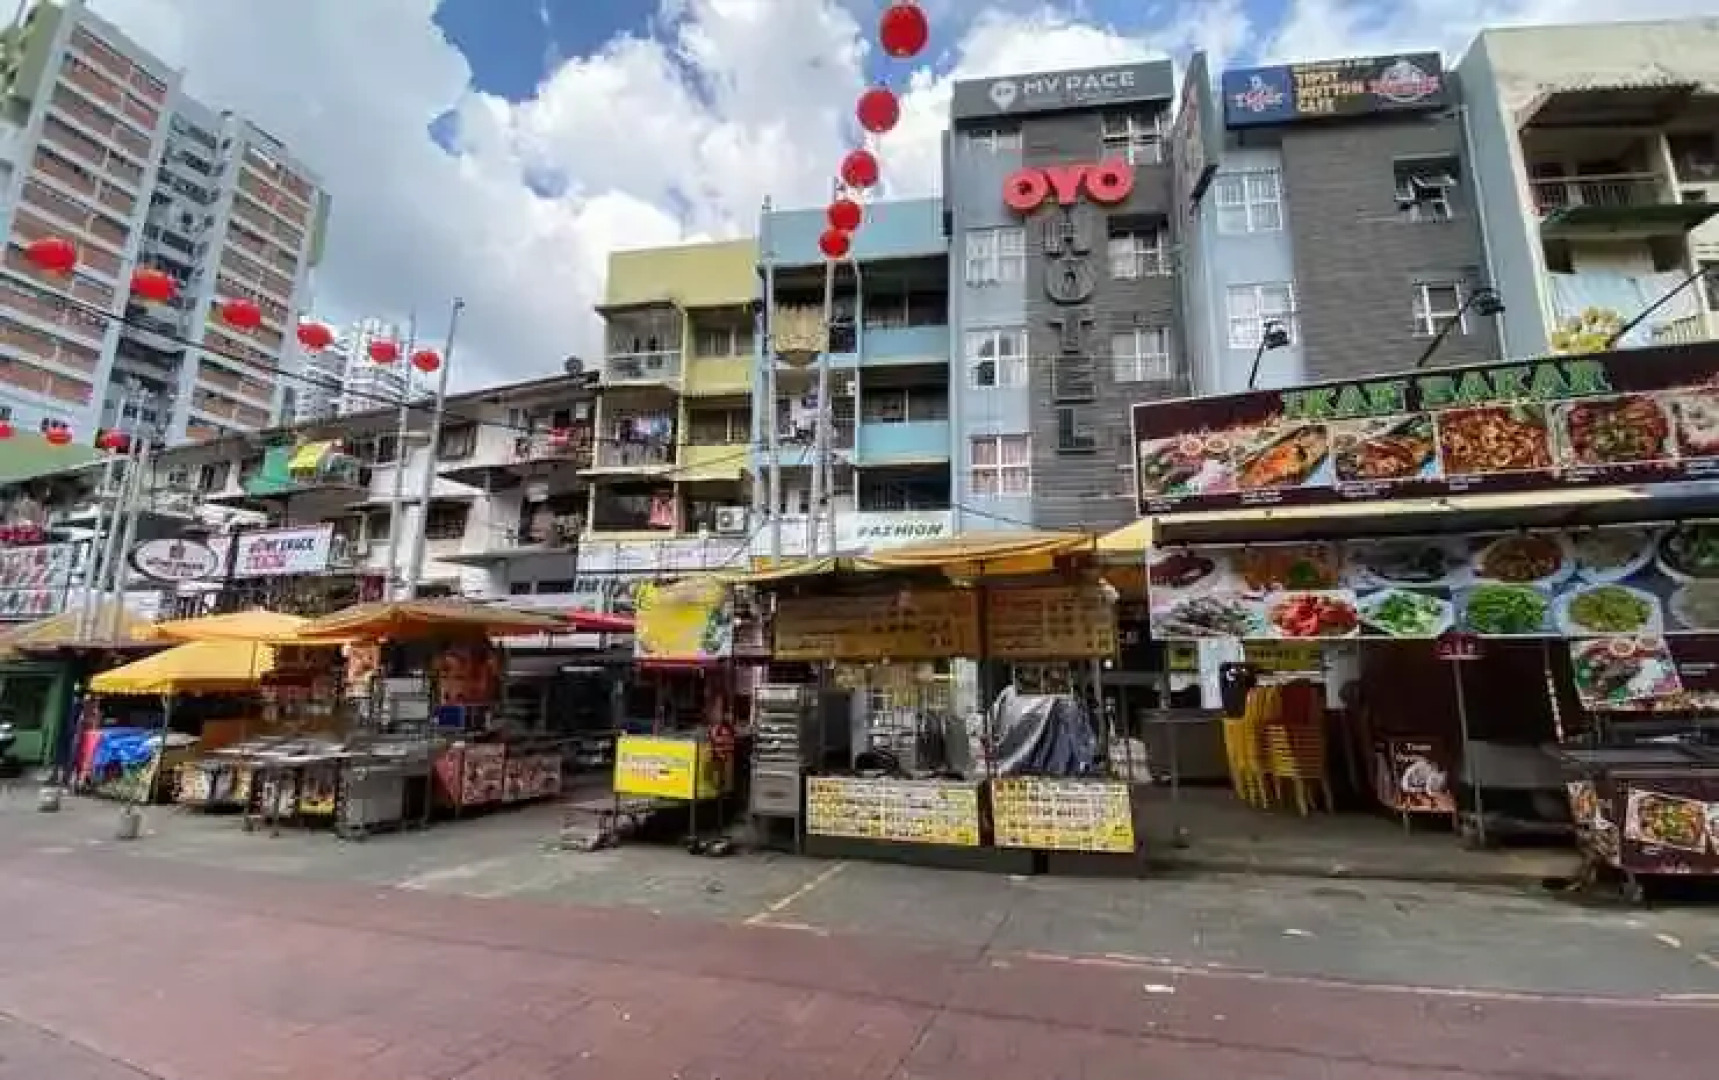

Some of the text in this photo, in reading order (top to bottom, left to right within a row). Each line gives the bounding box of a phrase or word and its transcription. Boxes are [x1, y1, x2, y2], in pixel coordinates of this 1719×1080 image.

[1065, 71, 1135, 91] PACE
[1003, 157, 1134, 210] OYO
[1043, 206, 1097, 455] HOTEL
[857, 522, 944, 538] FASHION
